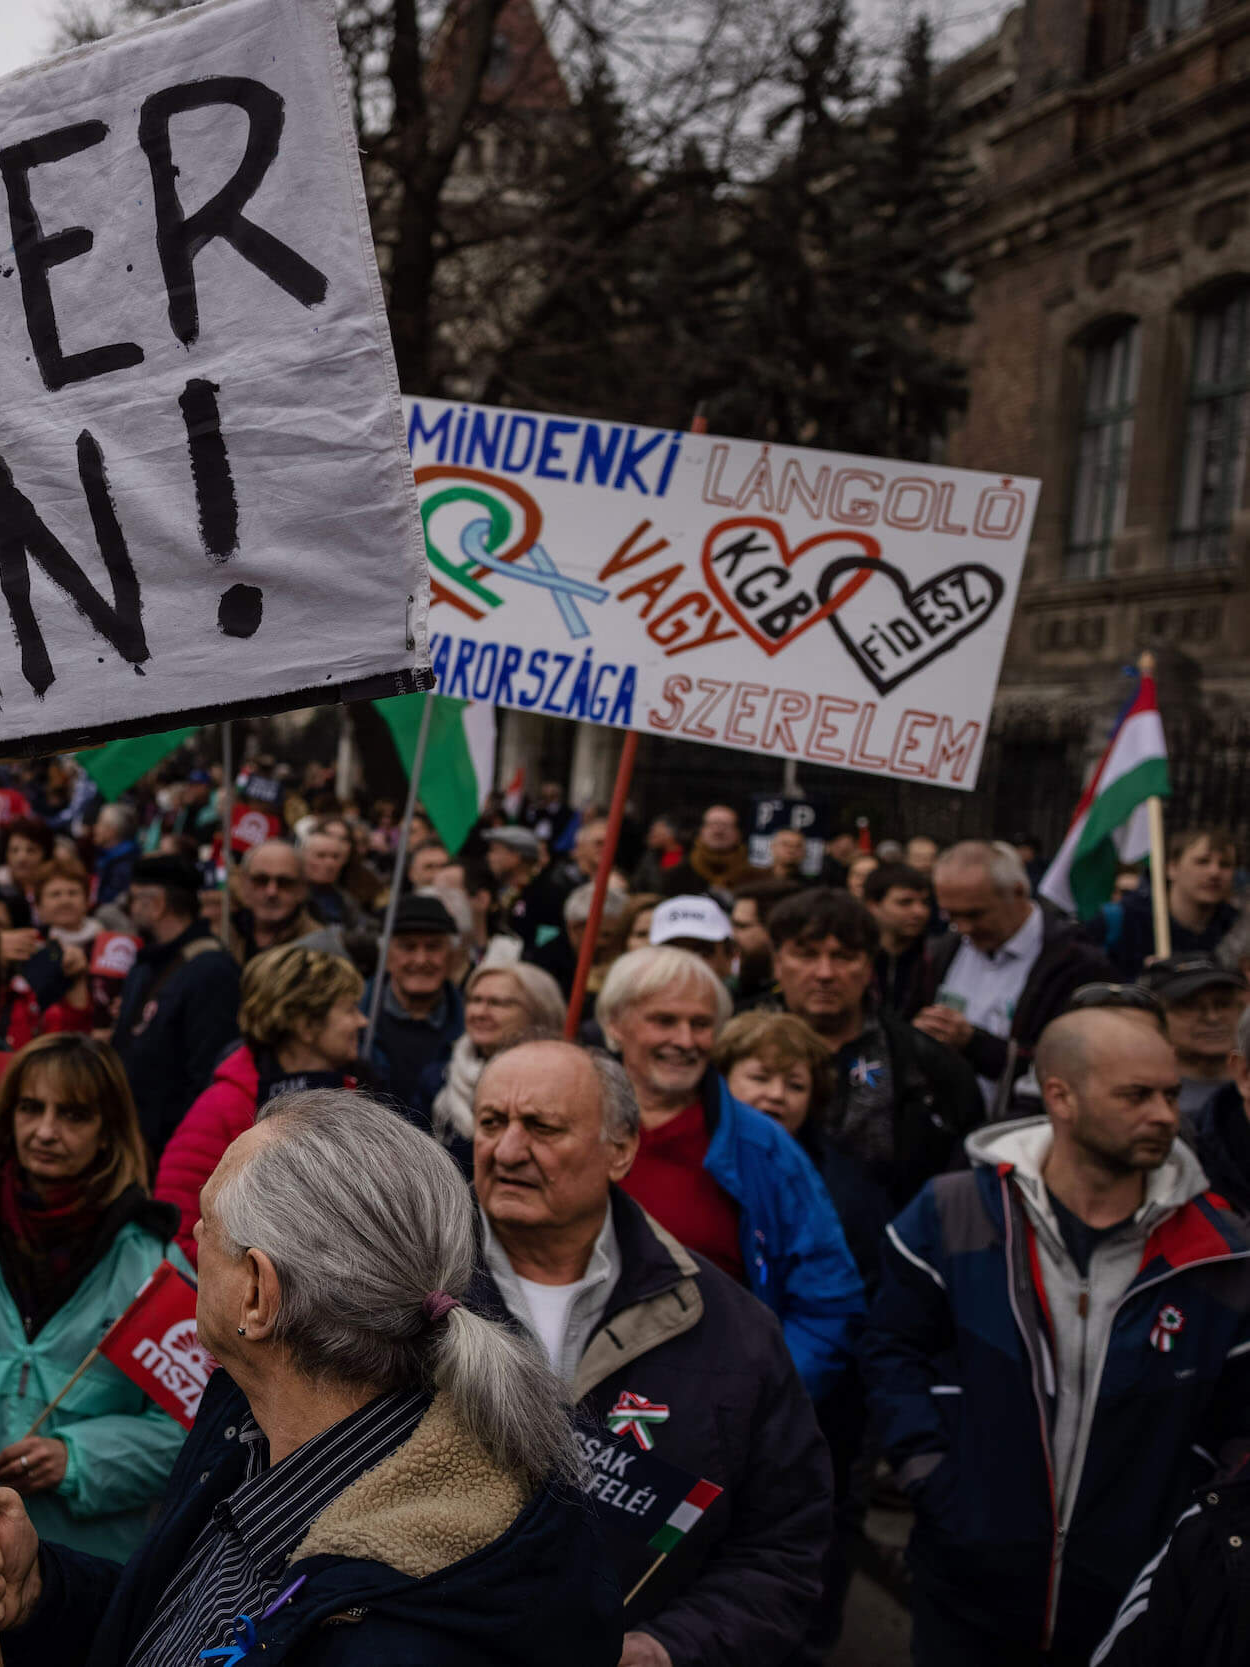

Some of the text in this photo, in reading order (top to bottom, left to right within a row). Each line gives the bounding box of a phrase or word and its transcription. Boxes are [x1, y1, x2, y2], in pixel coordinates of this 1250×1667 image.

[702, 443, 1026, 540] LÁNGOLÓ
[597, 520, 739, 657] VAGY
[713, 531, 814, 638] KGB
[429, 632, 638, 726] ARORSZÁGA
[648, 674, 982, 784] SZERELEM
